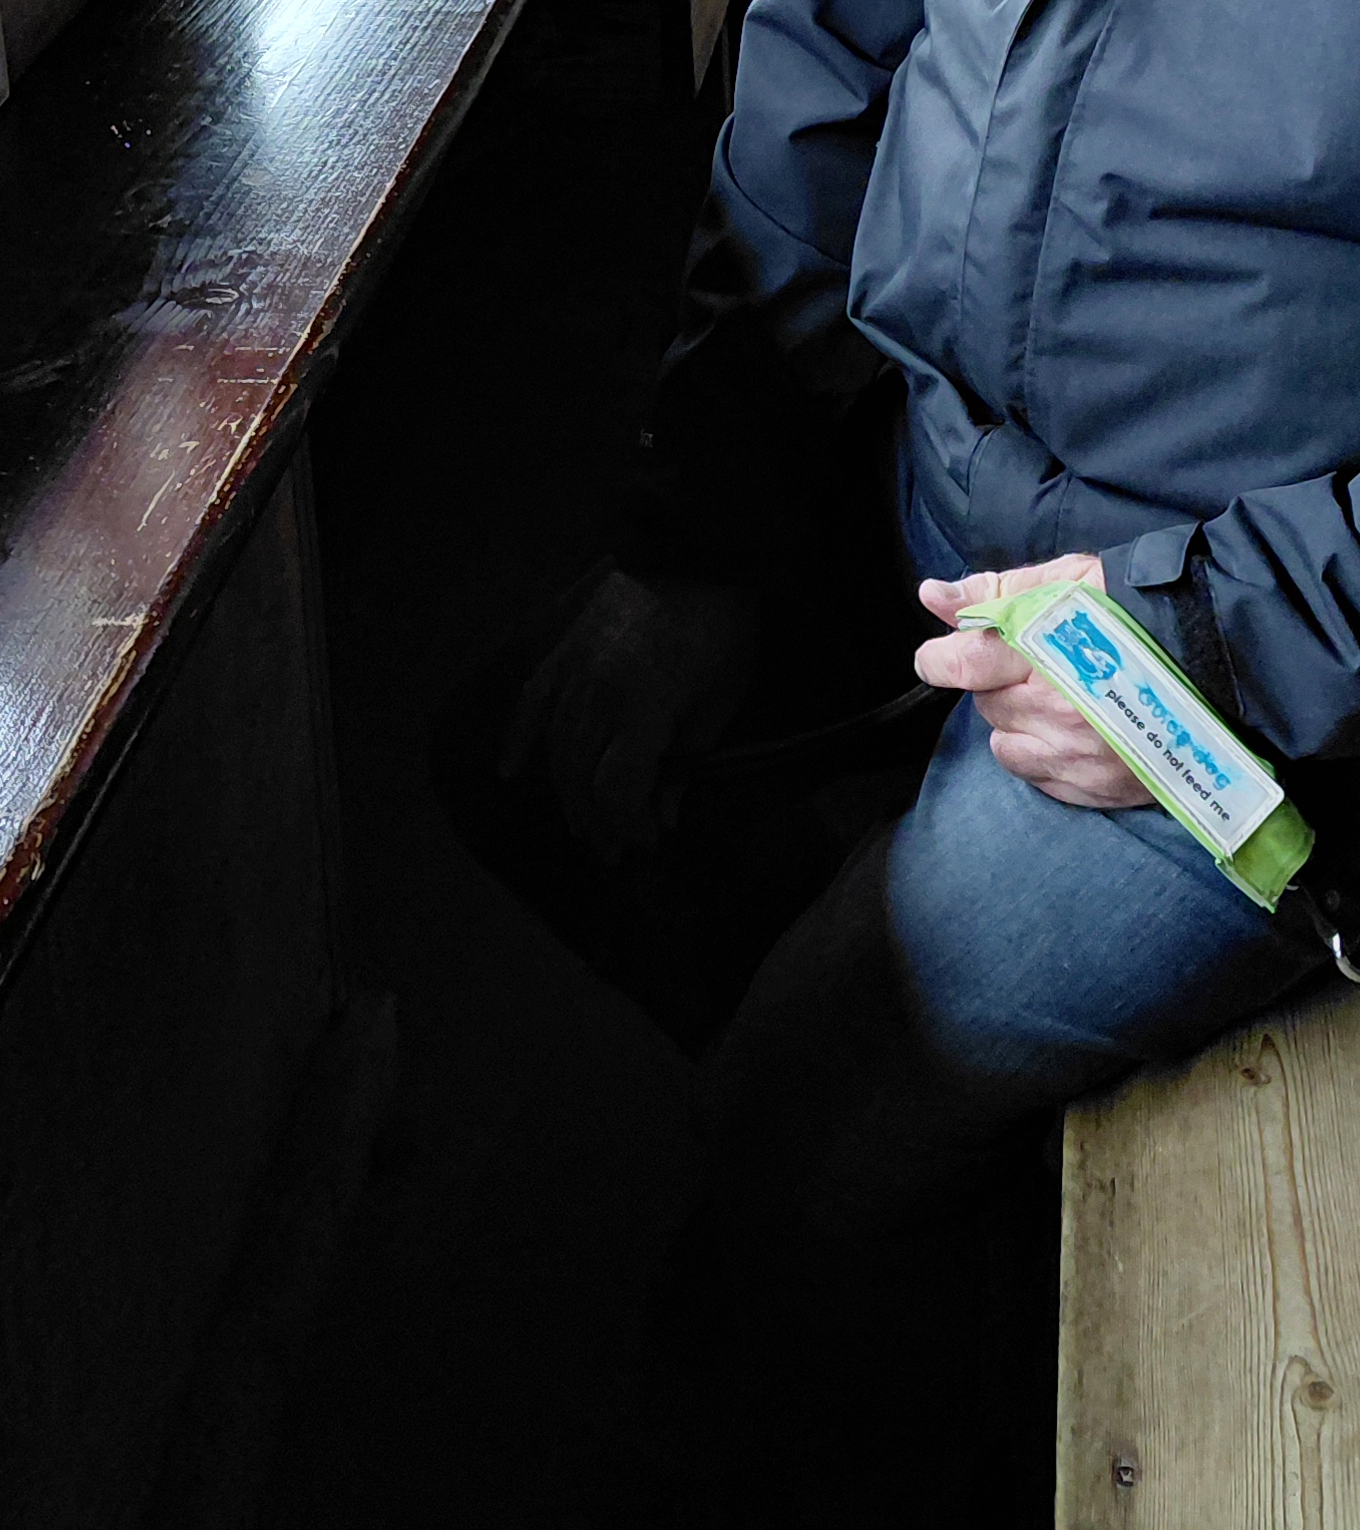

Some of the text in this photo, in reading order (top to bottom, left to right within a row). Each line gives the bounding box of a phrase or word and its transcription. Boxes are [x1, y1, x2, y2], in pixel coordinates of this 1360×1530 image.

[1105, 689, 1231, 822] please do not feed me
